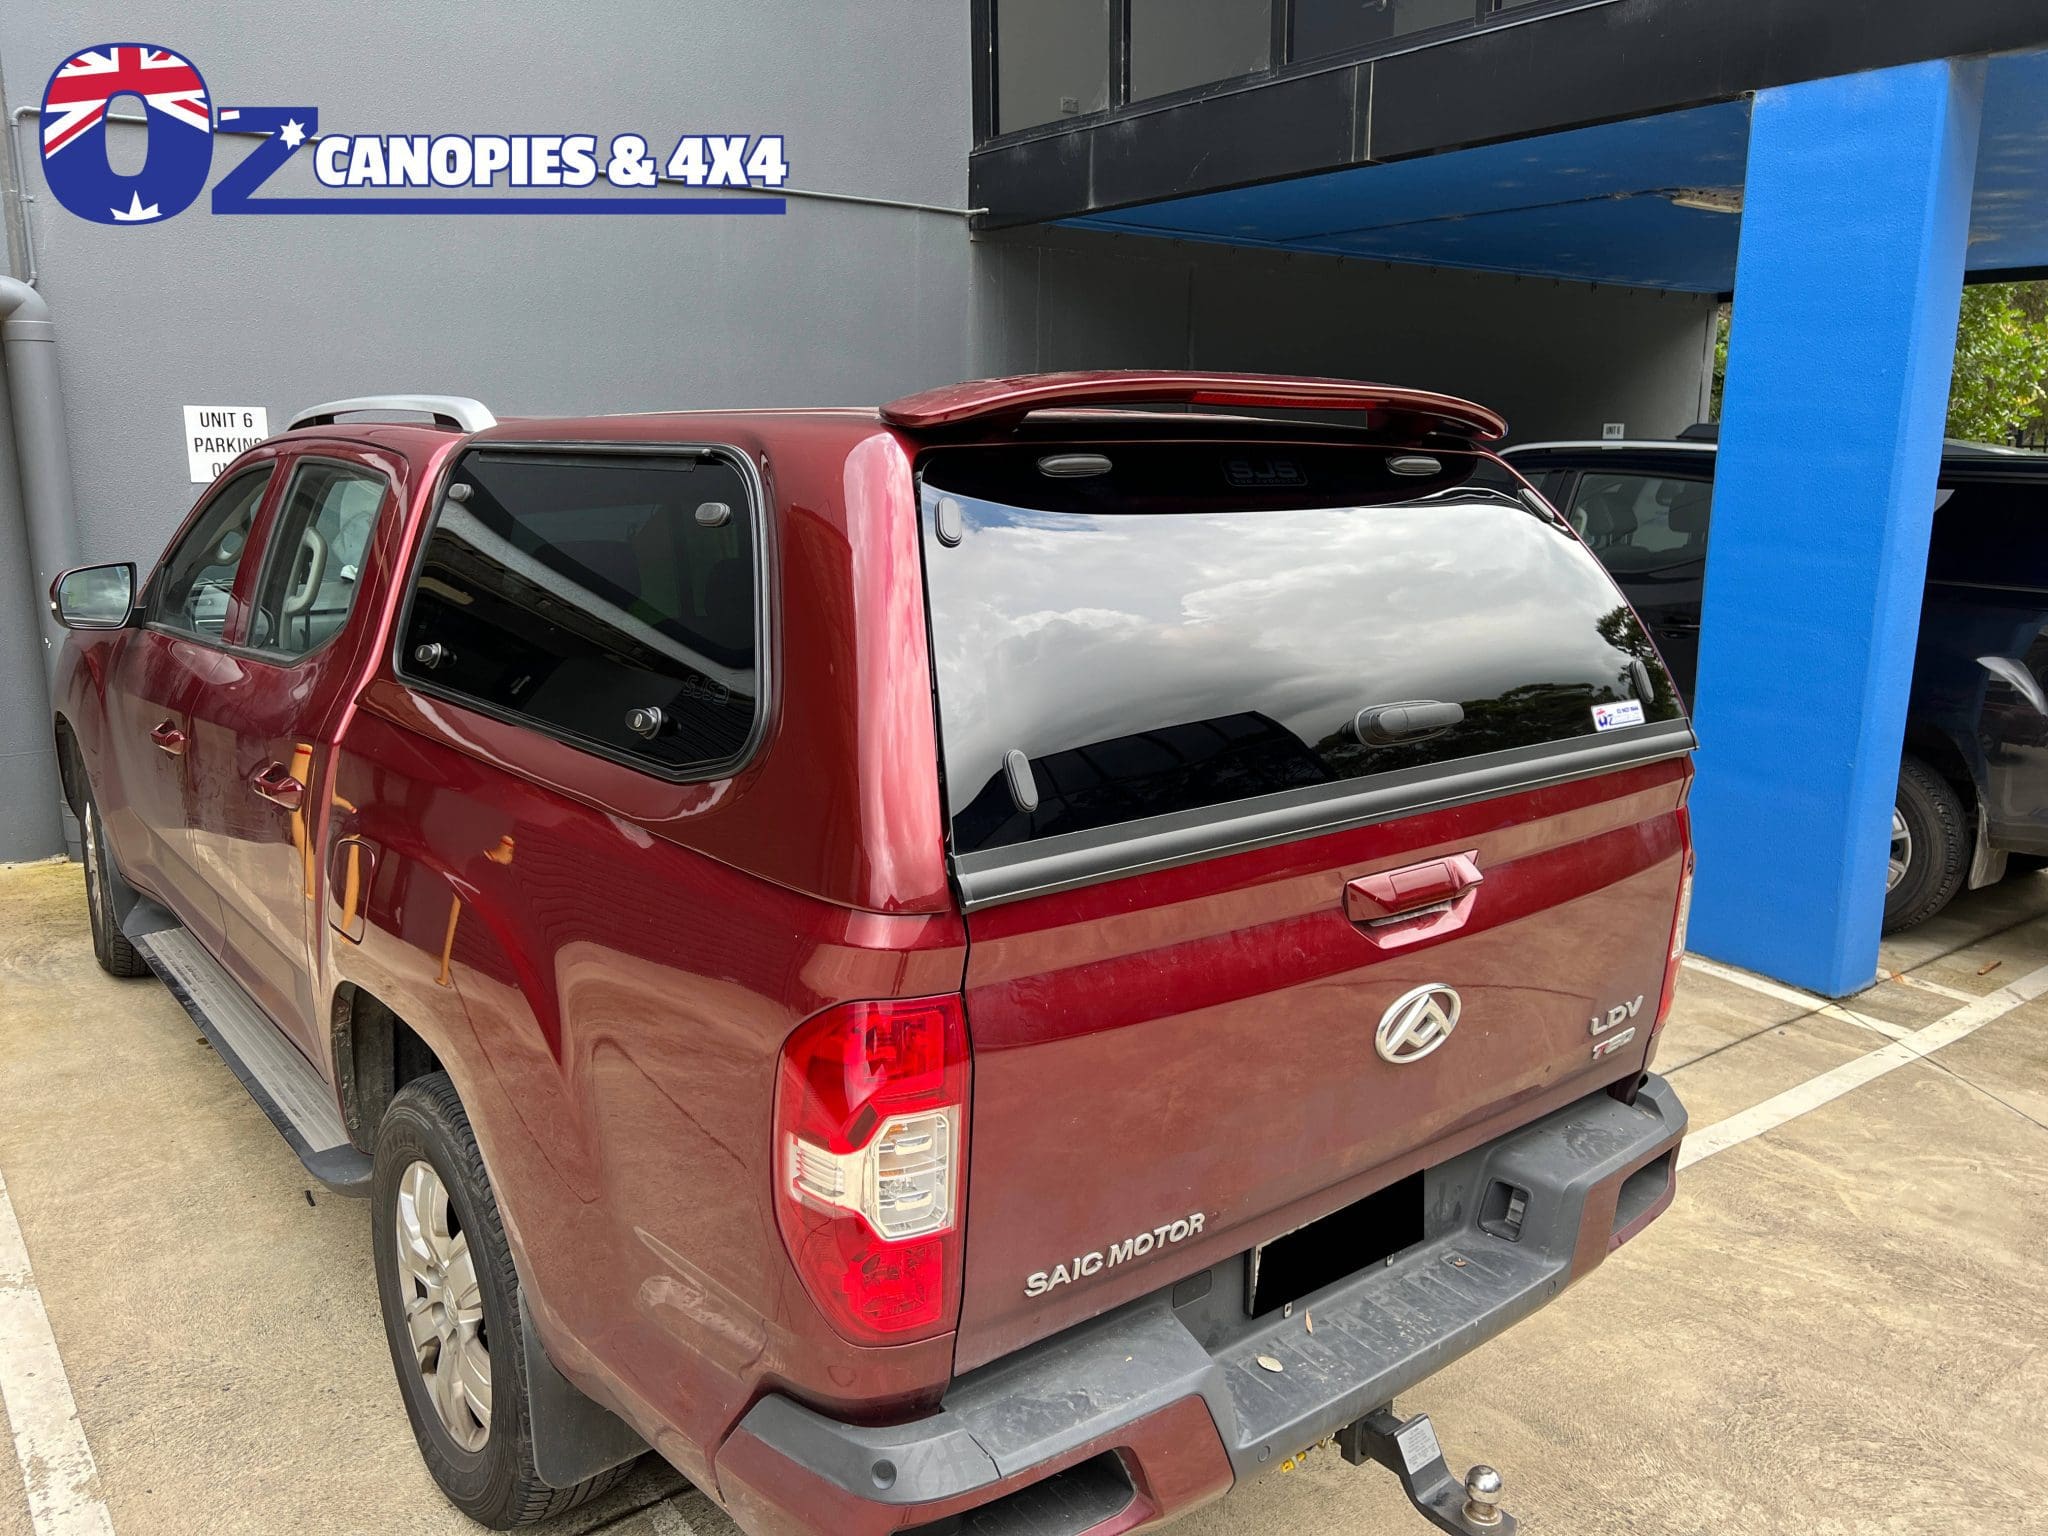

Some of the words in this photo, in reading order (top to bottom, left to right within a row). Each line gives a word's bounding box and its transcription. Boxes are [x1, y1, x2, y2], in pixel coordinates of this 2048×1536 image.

[200, 412, 236, 428] UNIT
[243, 412, 253, 428] 6
[1590, 994, 1644, 1036] LDV
[1024, 1251, 1104, 1298] SAIC
[1107, 1212, 1206, 1268] MOTOR
